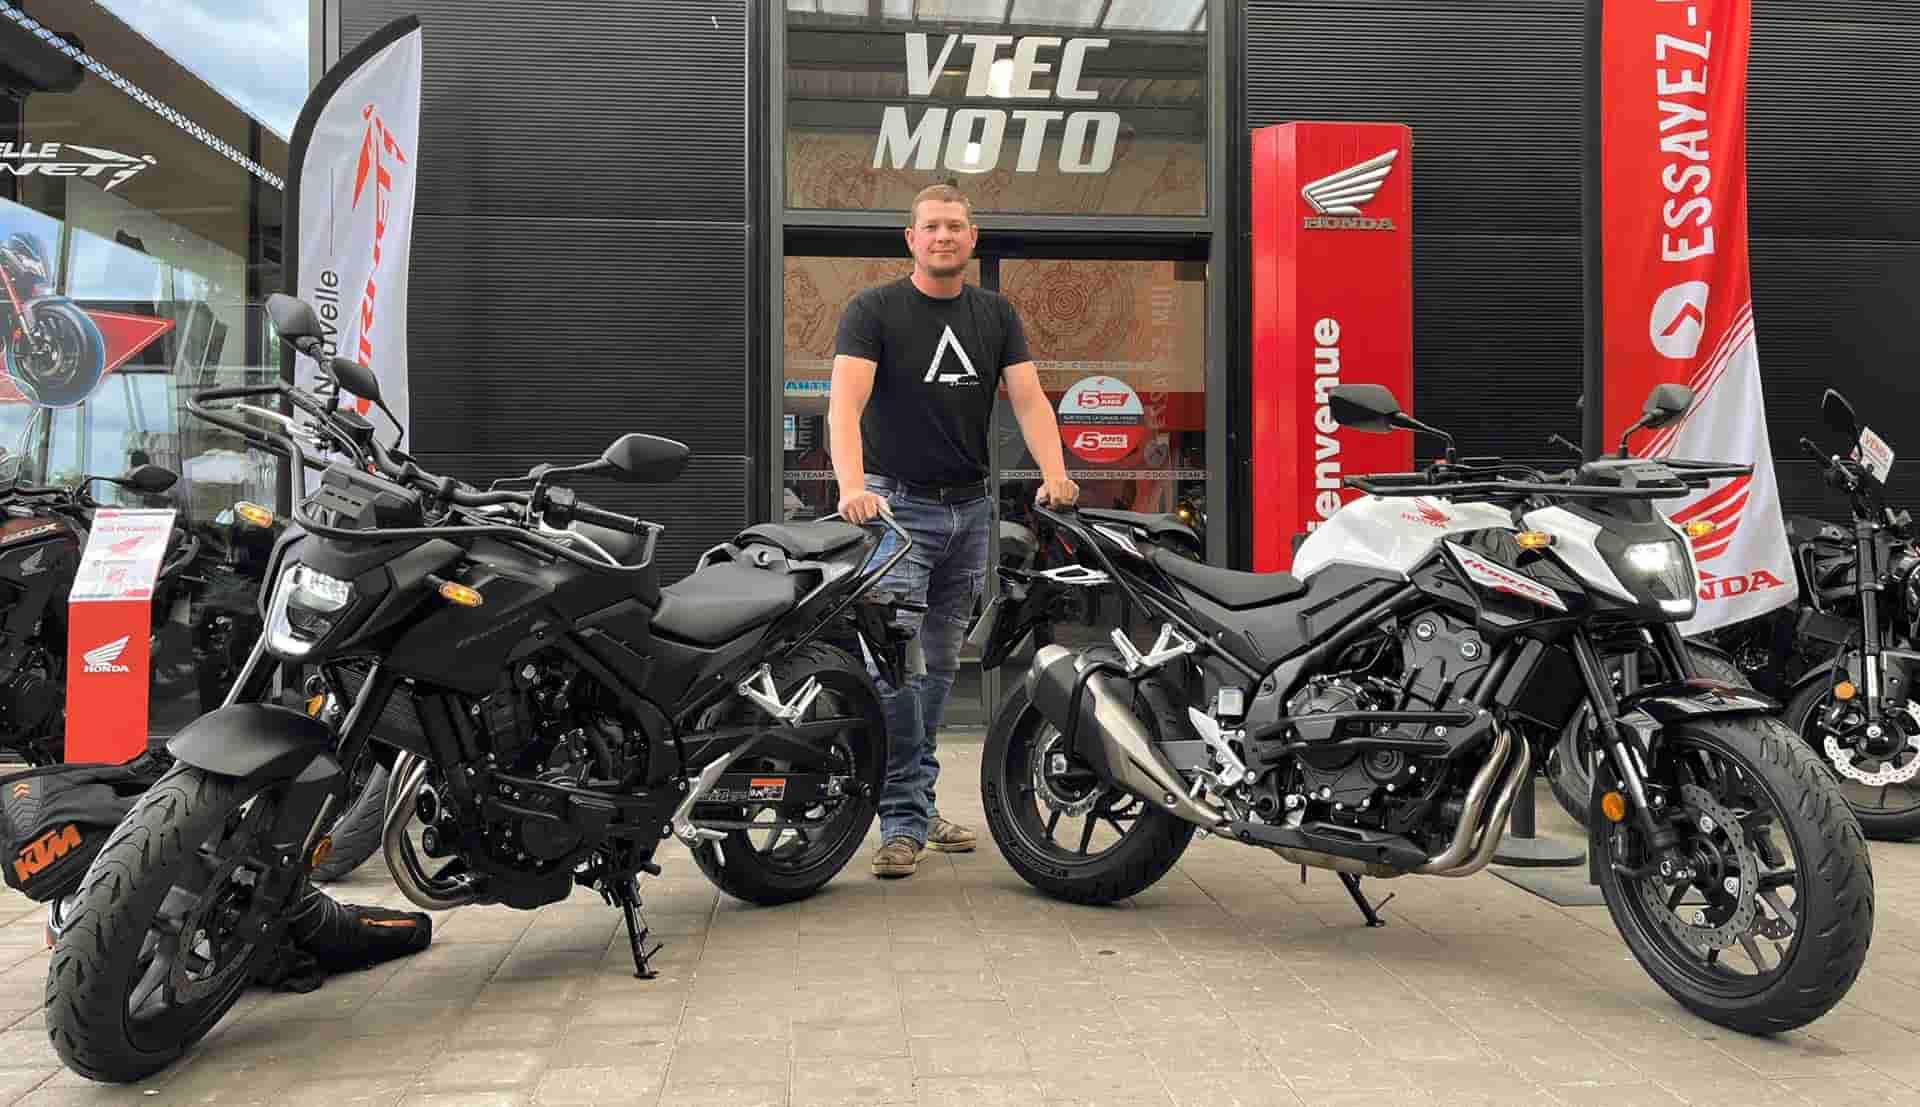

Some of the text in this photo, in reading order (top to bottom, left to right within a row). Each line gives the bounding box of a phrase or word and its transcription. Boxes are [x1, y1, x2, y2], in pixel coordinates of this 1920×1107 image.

[905, 32, 1111, 100] VTEC
[872, 106, 1120, 174] MOTO
[1656, 0, 1715, 262] ESSAYEZ-
[1303, 216, 1398, 231] HONDA
[1081, 389, 1101, 409] 5
[1082, 431, 1100, 450] 5
[84, 663, 130, 673] HONDA
[16, 823, 82, 881] KTM
